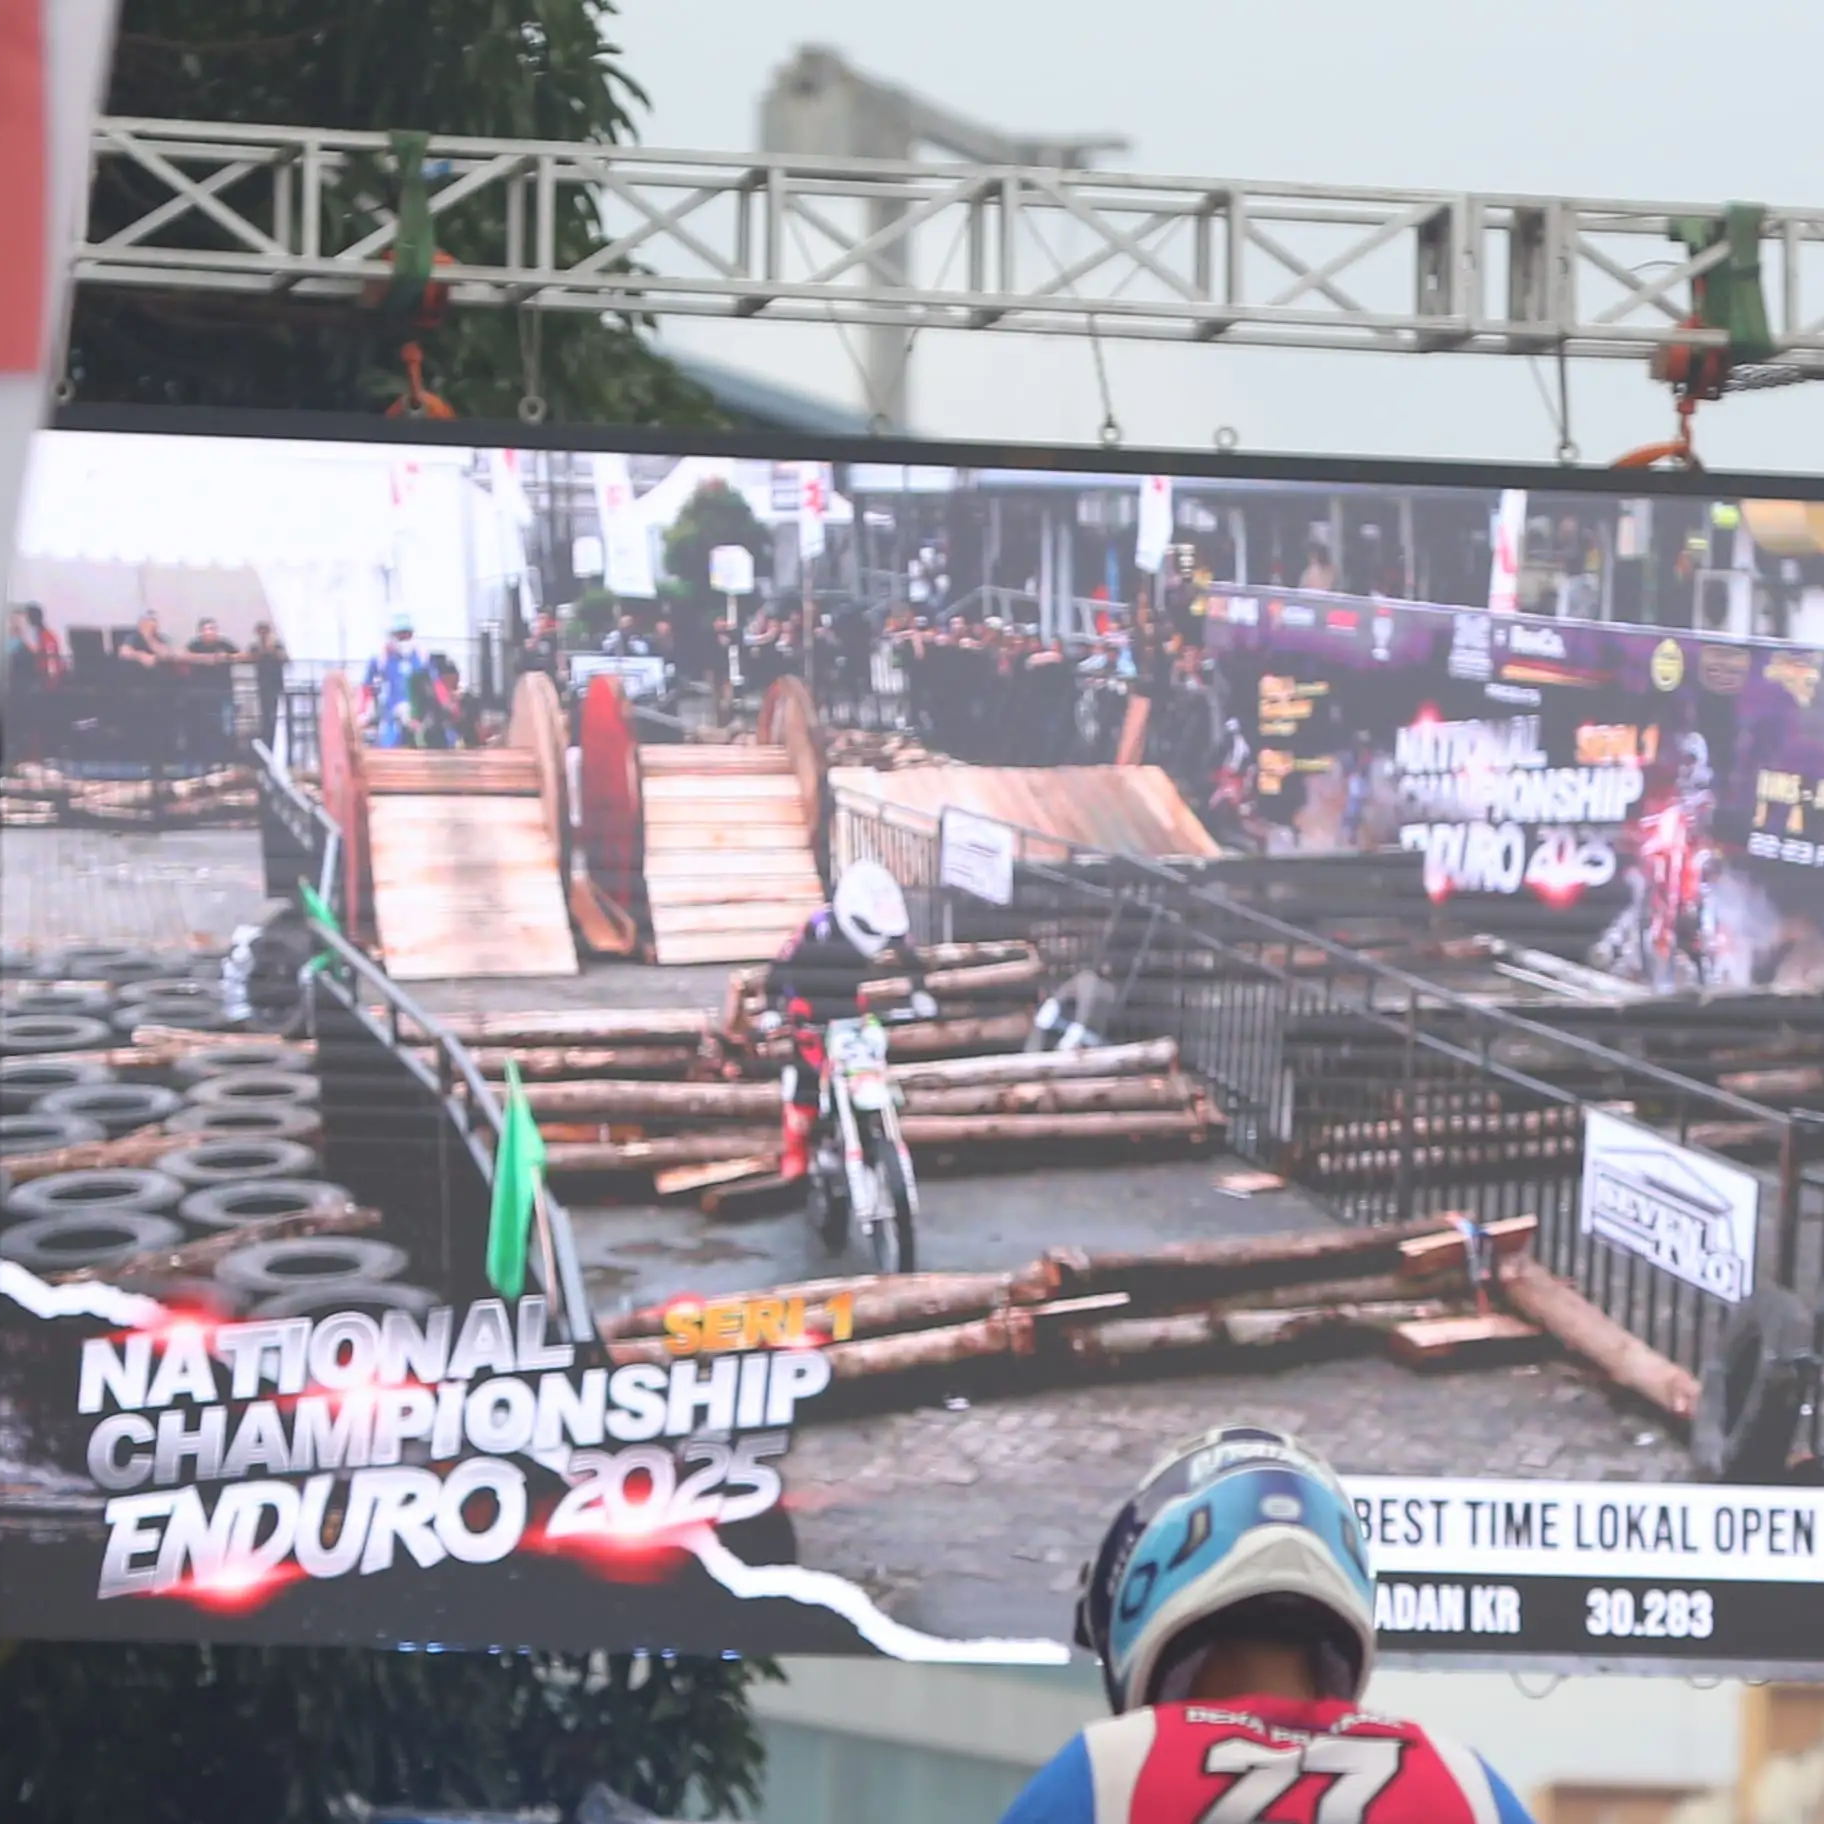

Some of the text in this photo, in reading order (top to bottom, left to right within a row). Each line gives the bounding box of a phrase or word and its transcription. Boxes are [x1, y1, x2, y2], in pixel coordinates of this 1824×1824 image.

[78, 1295, 574, 1413] NATIONAL
[662, 1290, 856, 1357] SERI 1
[85, 1350, 832, 1489] CHAMPIONSHIP
[97, 1434, 789, 1599] ENDURO 2025
[1353, 1498, 1816, 1556] BEST TIME LOKAL OPEN
[1470, 1586, 1521, 1635] KR
[1585, 1587, 1714, 1639] 30.283
